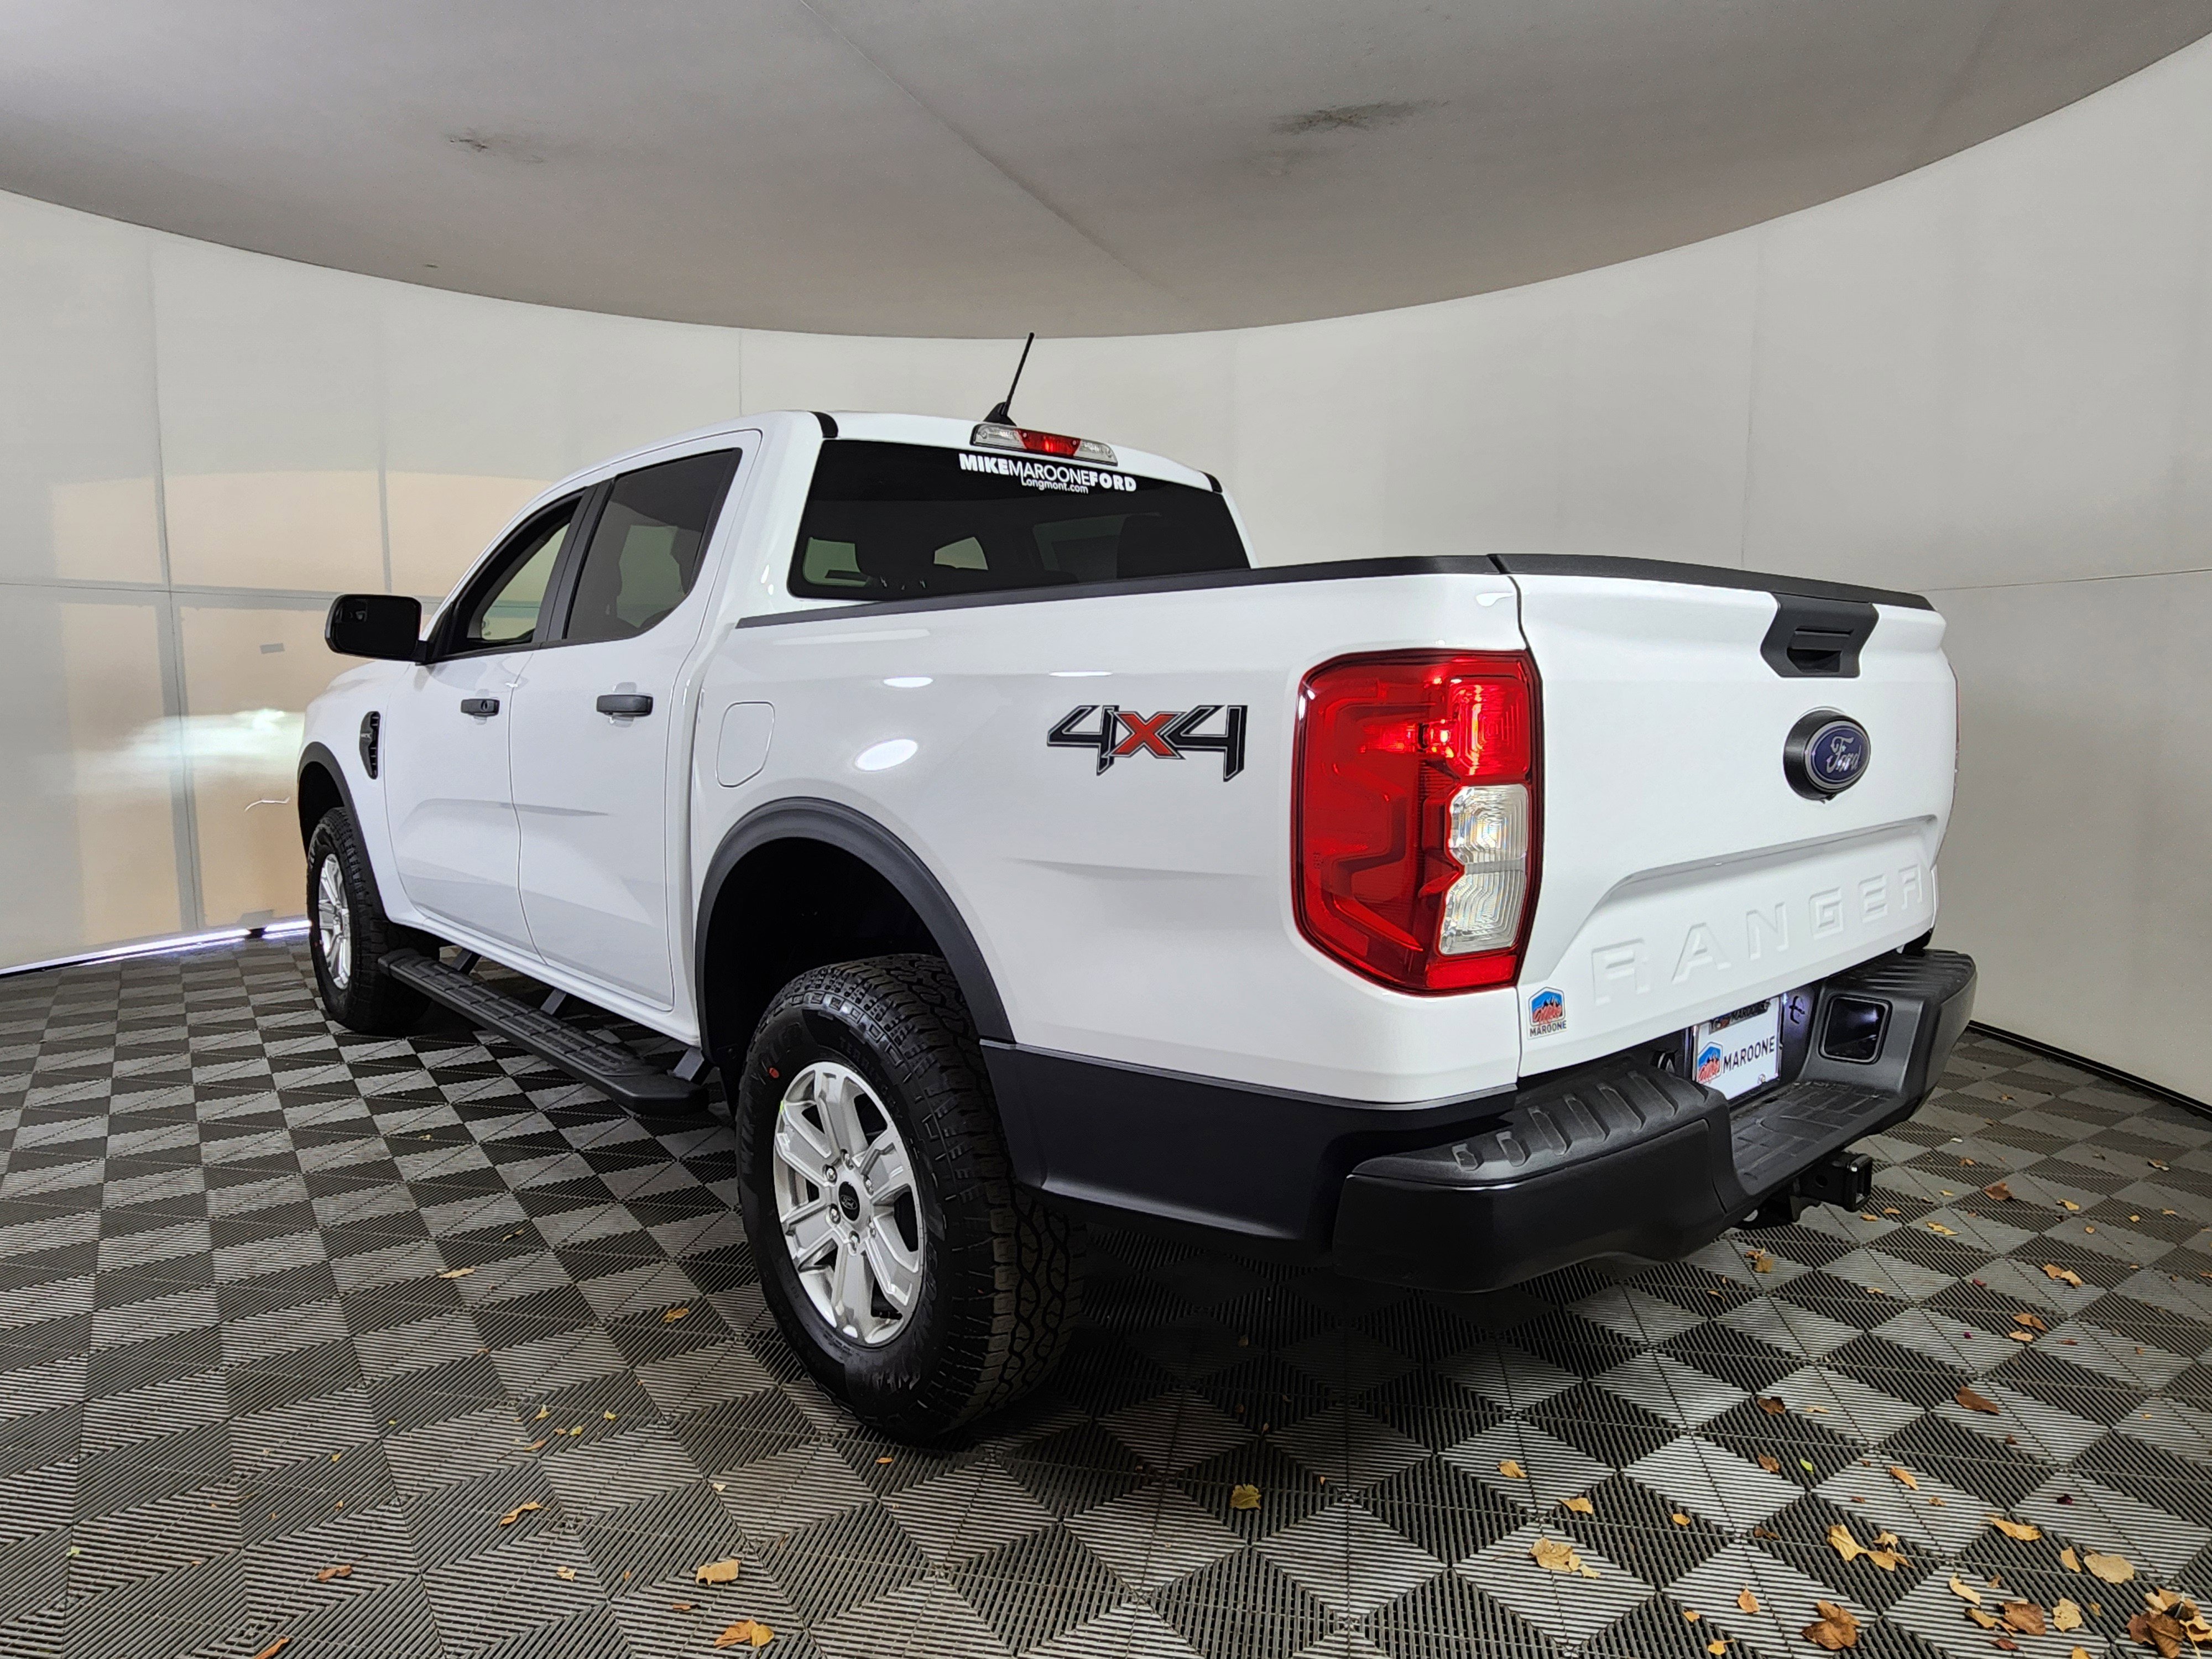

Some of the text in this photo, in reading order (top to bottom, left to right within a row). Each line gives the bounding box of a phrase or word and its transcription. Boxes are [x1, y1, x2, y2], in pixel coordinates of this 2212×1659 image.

[1021, 474, 1089, 494] Longmont.com
[1826, 735, 1862, 774] Ford
[1591, 863, 1923, 1006] RANGER
[1530, 1020, 1567, 1037] MAROONE
[1723, 1035, 1775, 1074] MAROONE
